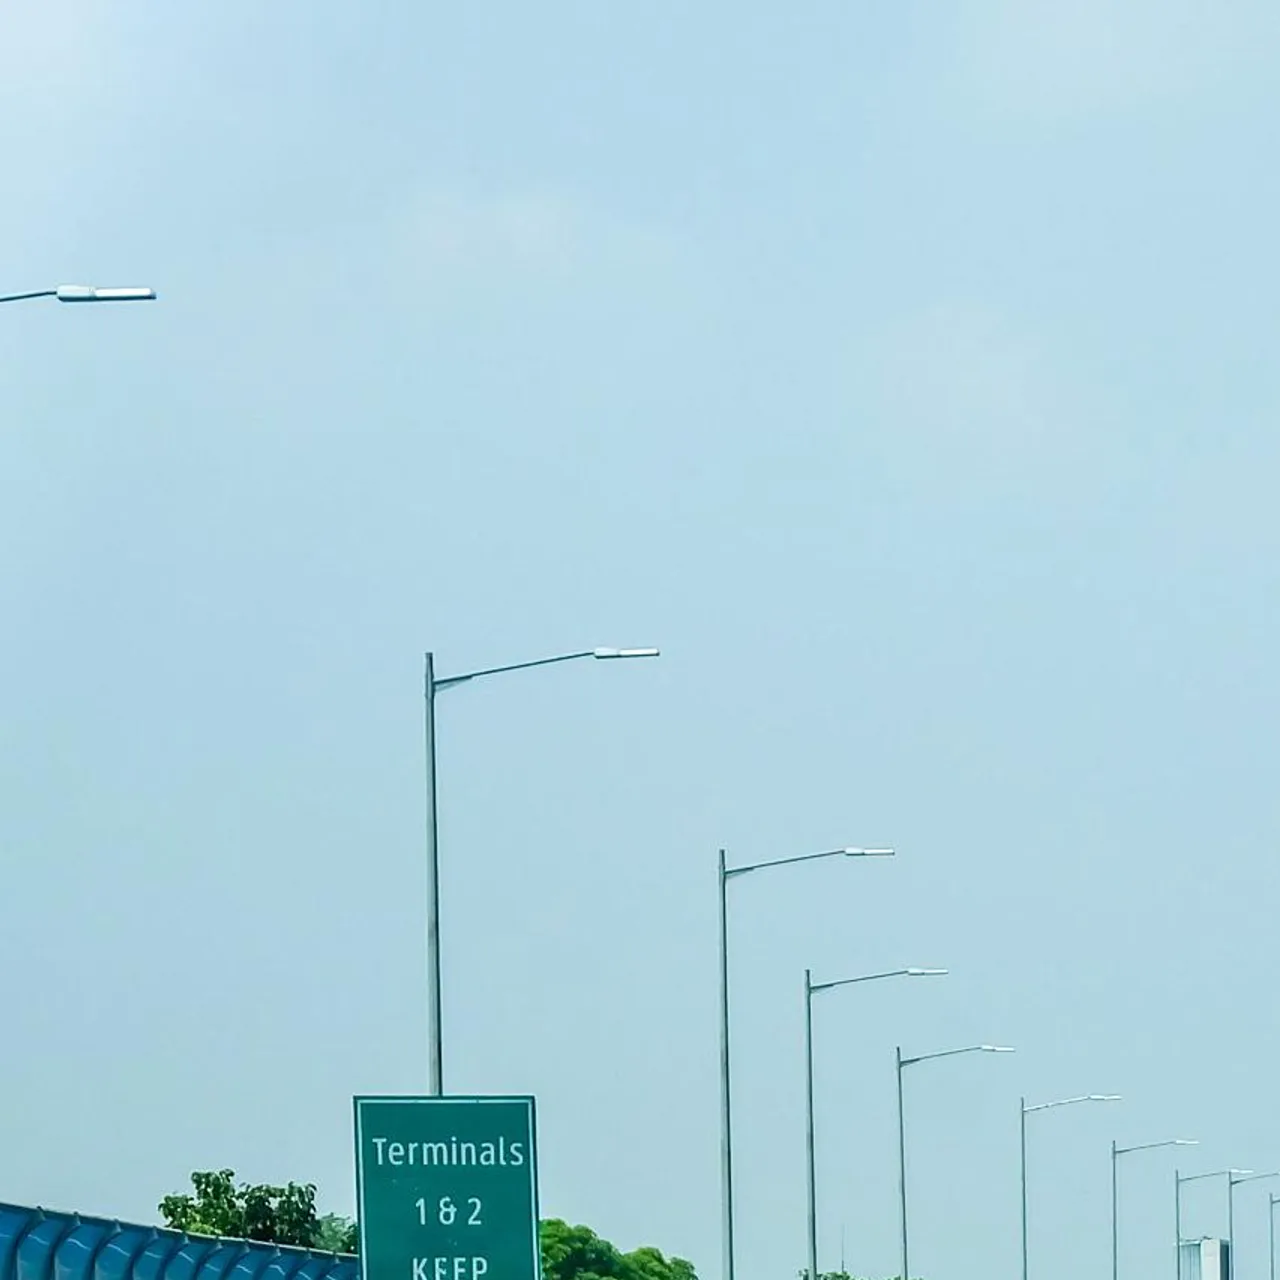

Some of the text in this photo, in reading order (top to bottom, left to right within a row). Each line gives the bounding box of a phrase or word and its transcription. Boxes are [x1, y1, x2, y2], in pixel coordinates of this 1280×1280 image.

[372, 1136, 525, 1167] Terminals
[414, 1196, 483, 1226] 1 & 2
